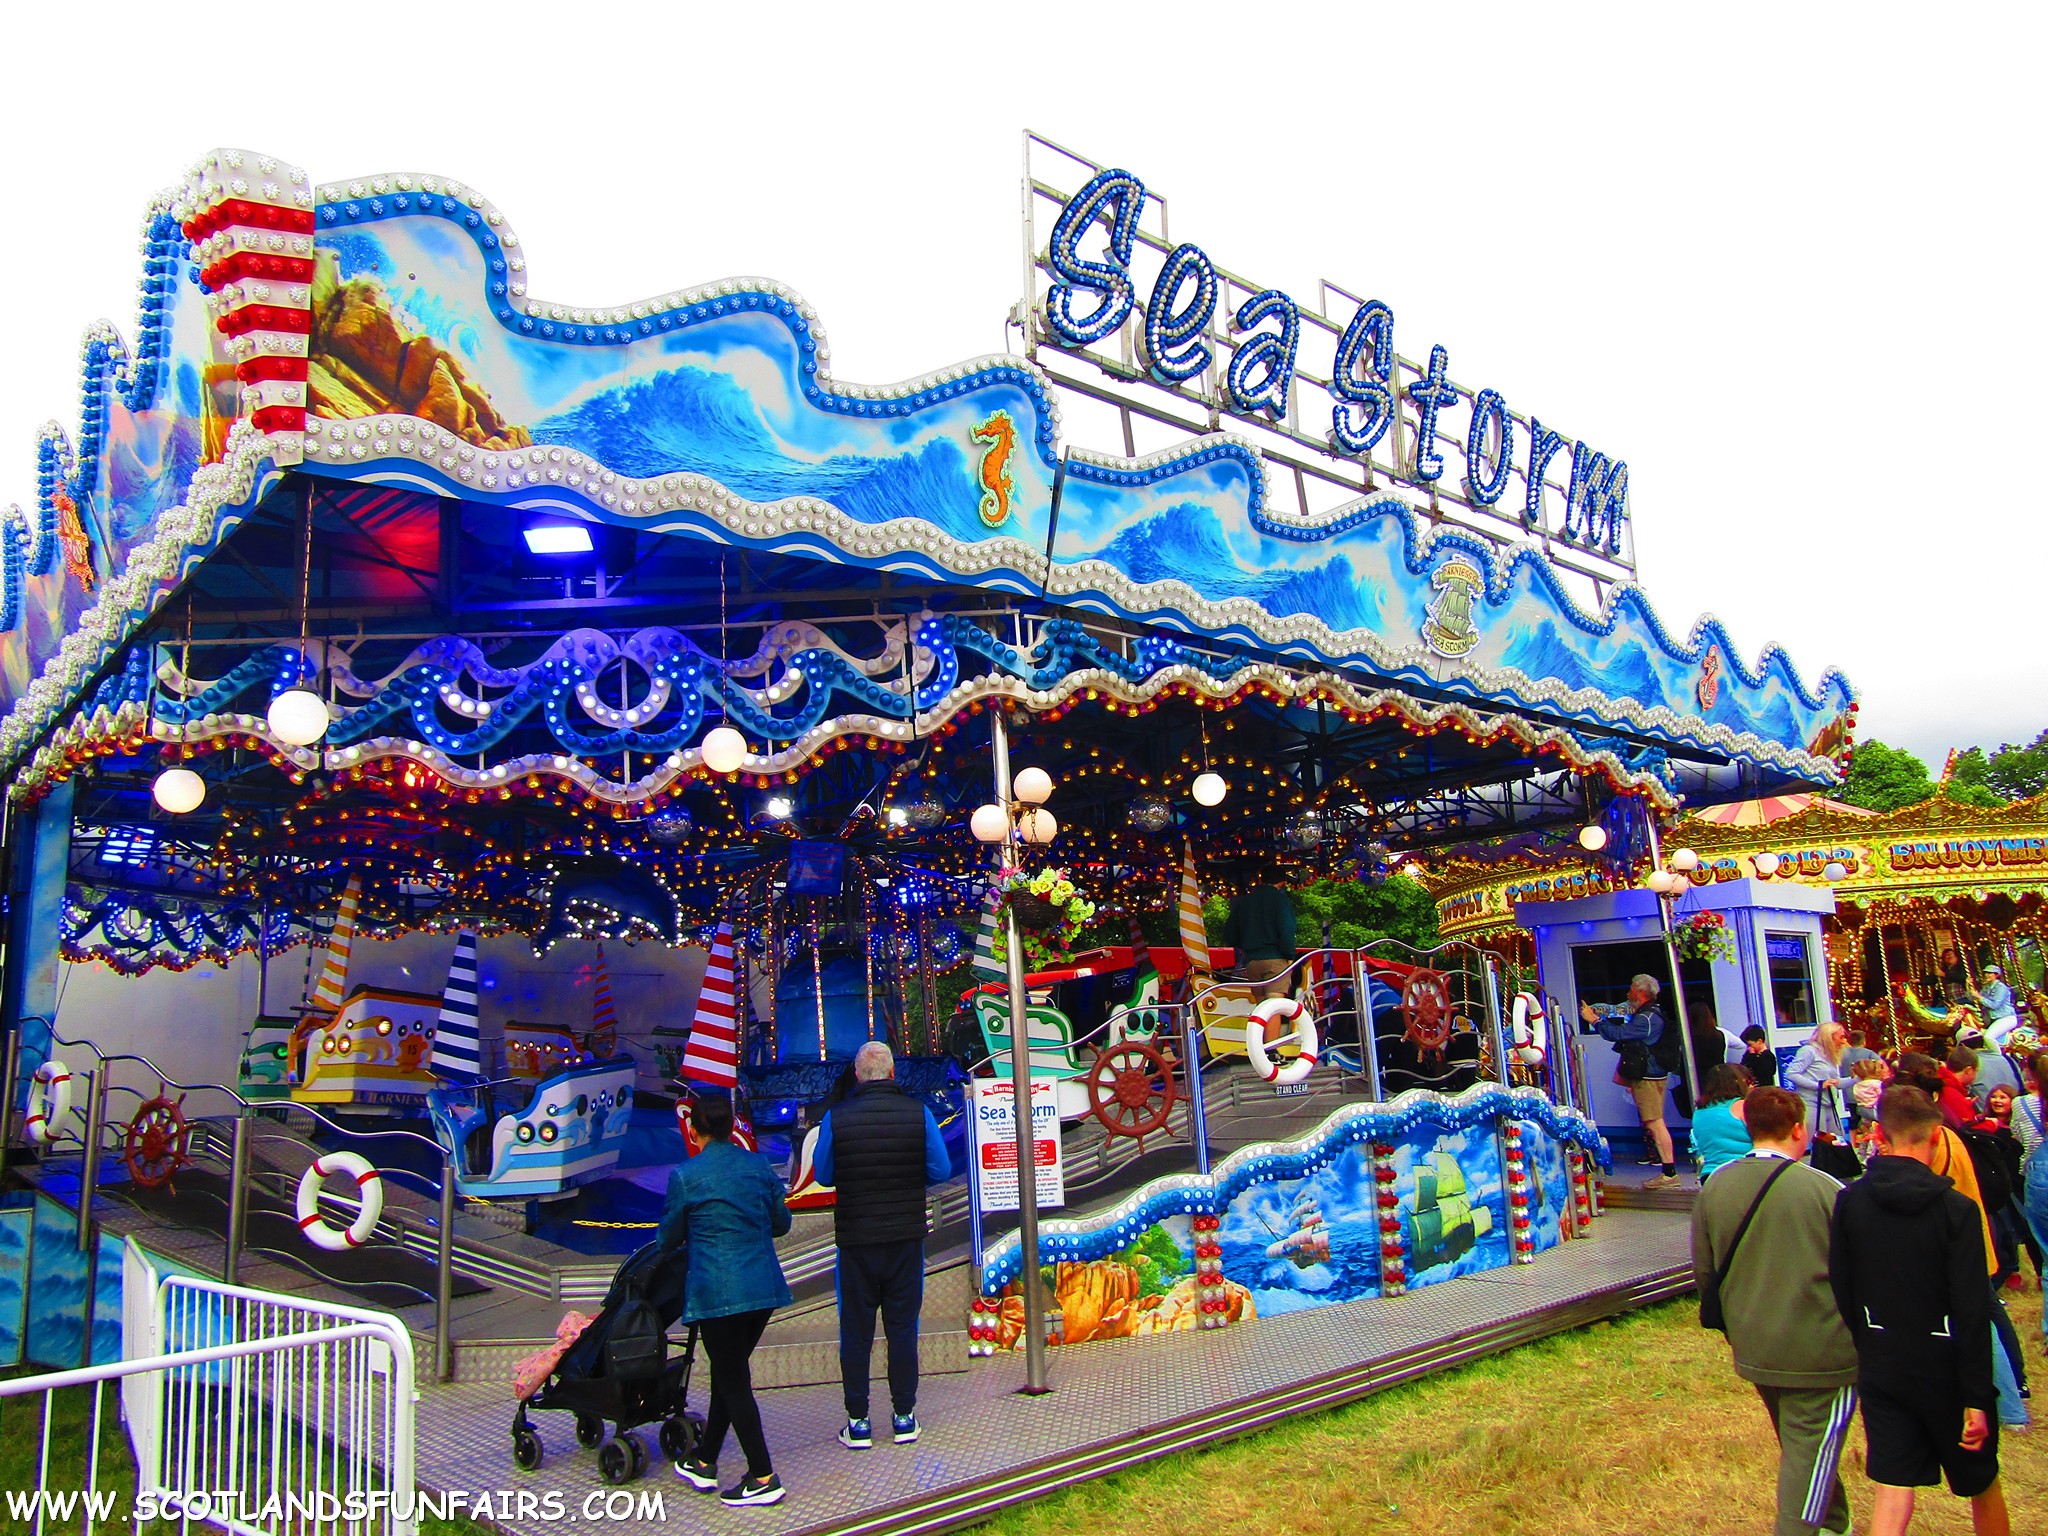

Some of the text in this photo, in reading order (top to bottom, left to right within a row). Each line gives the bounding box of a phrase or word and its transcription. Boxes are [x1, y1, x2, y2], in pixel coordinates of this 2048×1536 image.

[1045, 168, 1630, 556] Sea Storm
[1666, 857, 1742, 887] OR
[1749, 847, 1859, 881] OUR
[1888, 838, 2048, 871] ENJOYME
[408, 1044, 418, 1056] 15
[993, 1085, 1015, 1093] Harnie
[1276, 1083, 1308, 1095] STAND CLEAR
[980, 1105, 1056, 1120] Sea Sorm
